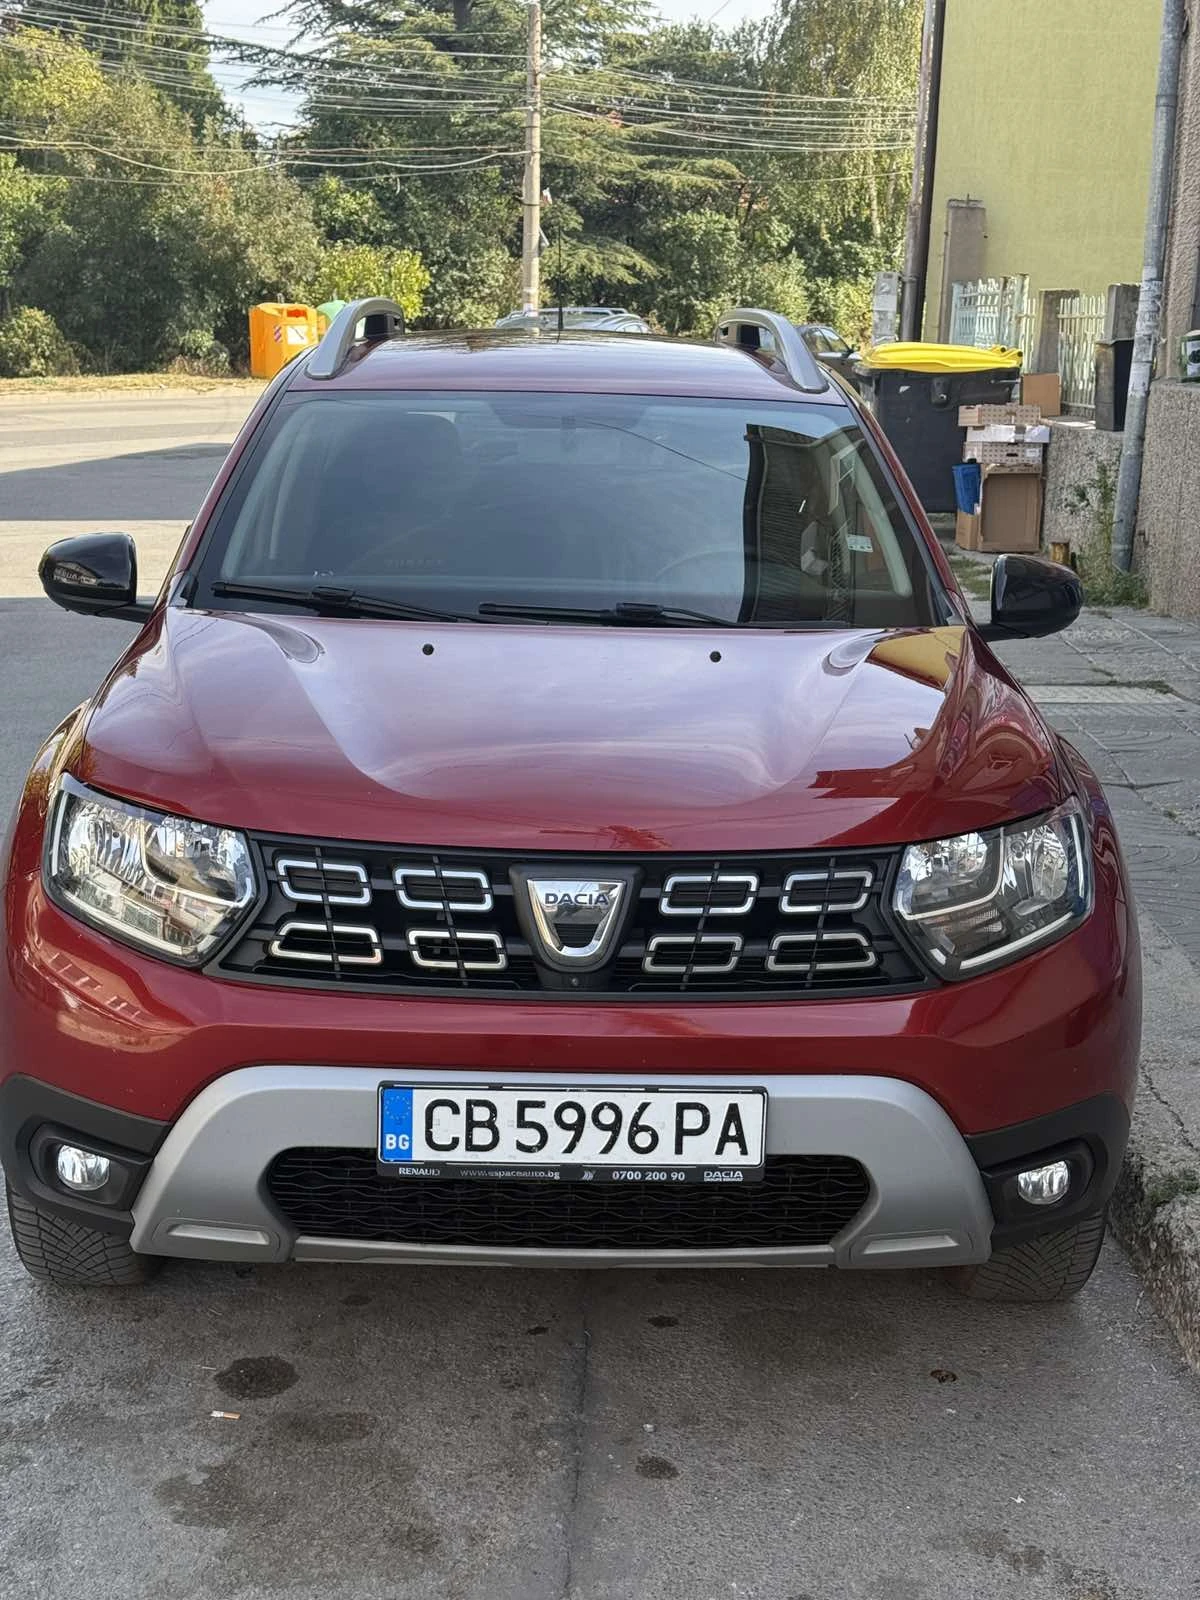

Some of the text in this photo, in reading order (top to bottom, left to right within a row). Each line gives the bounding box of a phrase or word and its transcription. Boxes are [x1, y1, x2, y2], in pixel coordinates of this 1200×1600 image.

[544, 892, 609, 905] DACIA
[424, 1098, 749, 1156] CB 5996 PA
[385, 1133, 410, 1151] BG
[612, 1170, 686, 1181] 0700 200 90
[703, 1170, 744, 1178] DACIA
